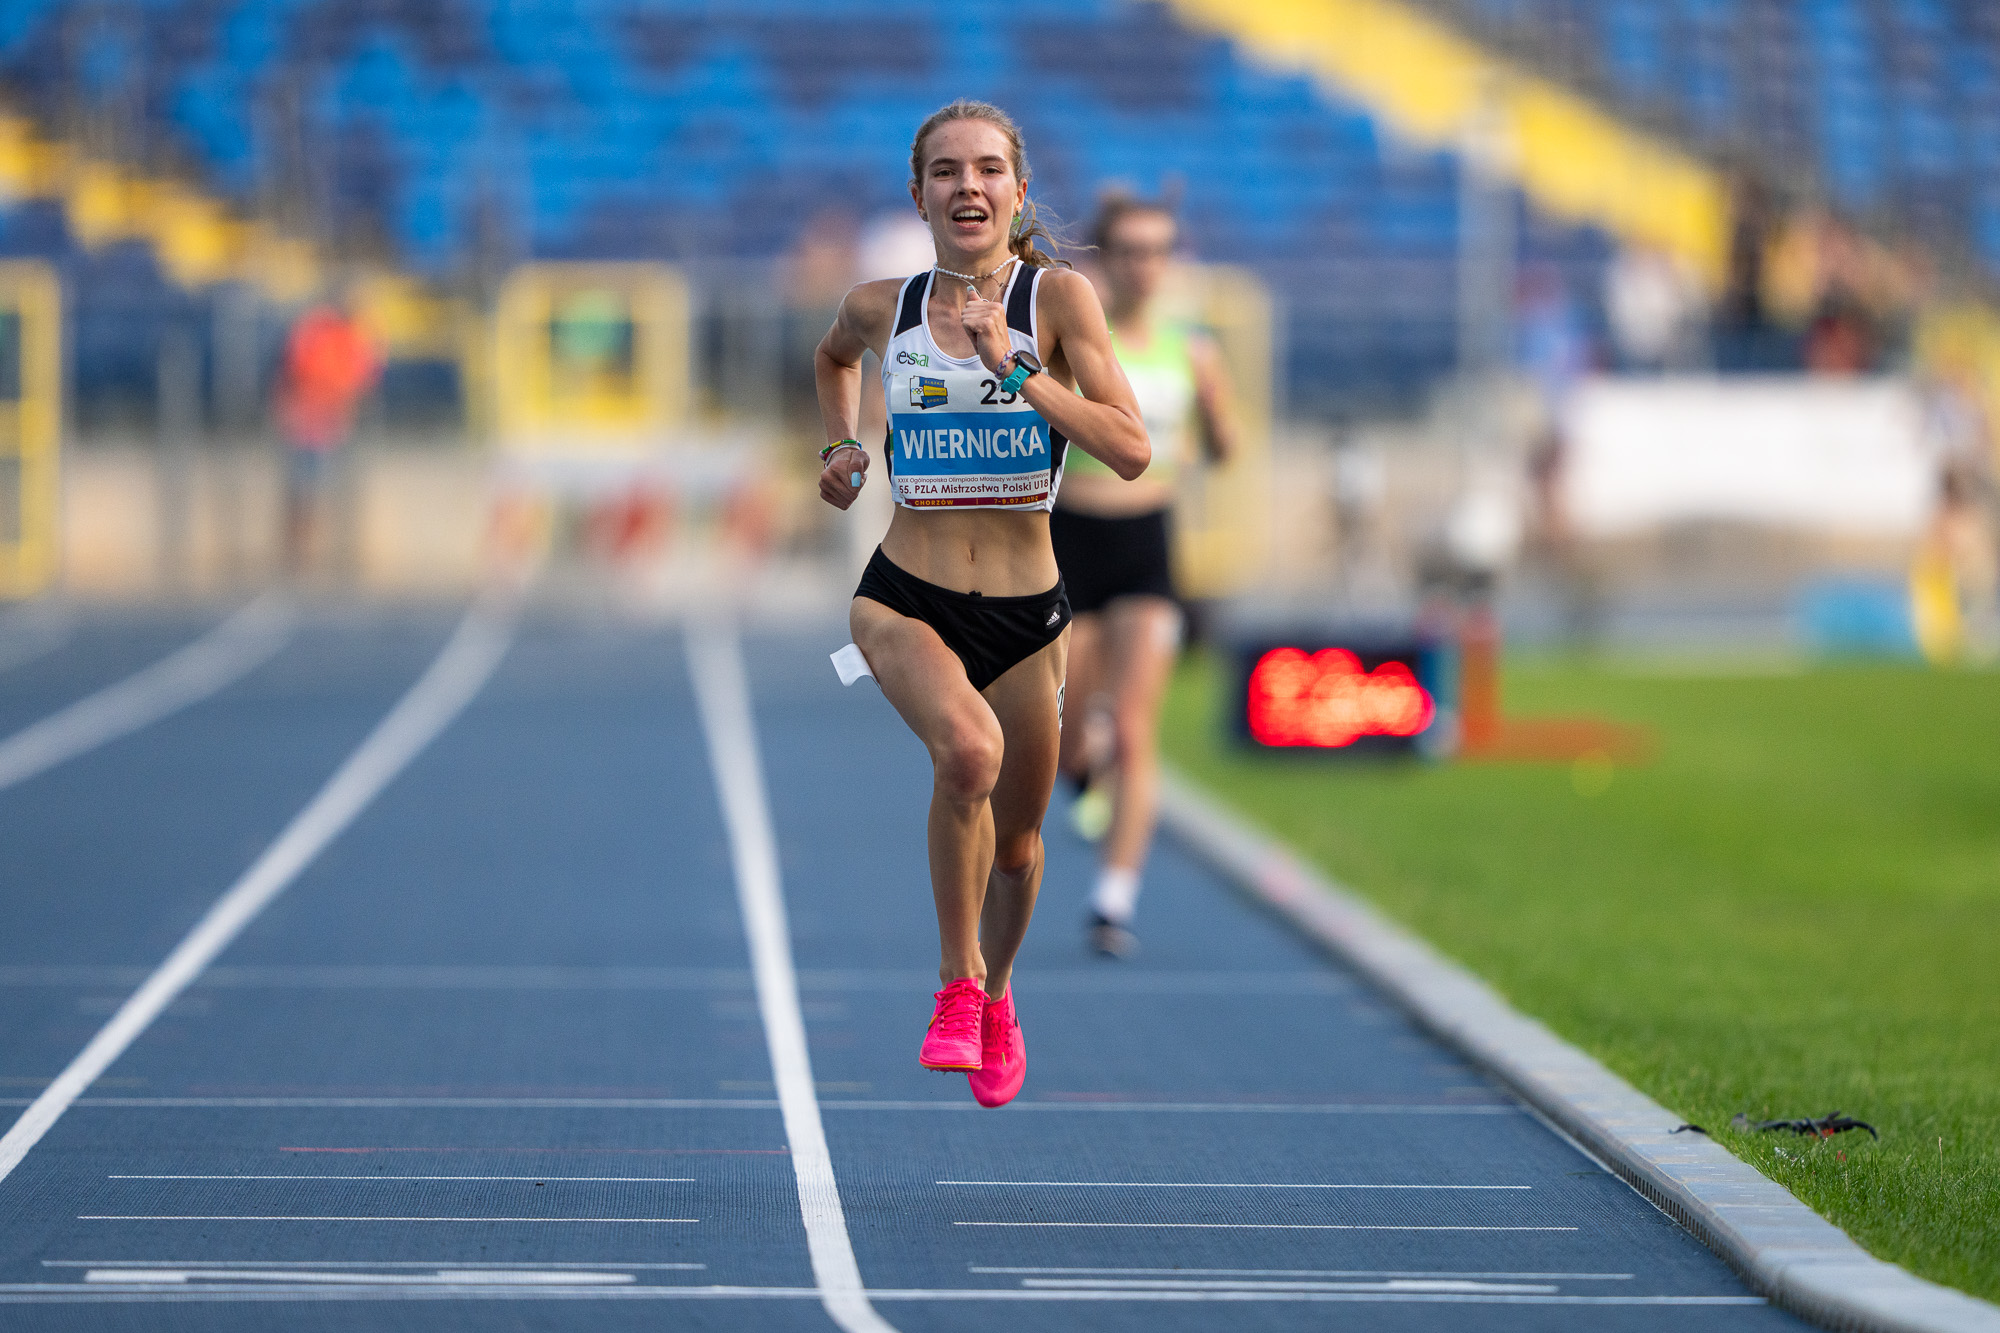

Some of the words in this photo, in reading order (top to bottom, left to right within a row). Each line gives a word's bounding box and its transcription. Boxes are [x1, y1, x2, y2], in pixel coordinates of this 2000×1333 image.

[980, 378, 1026, 405] 25
[900, 426, 1045, 459] WIERNICKA
[910, 477, 947, 485] Ogólnopolska
[980, 475, 1005, 483] Młodzieży
[915, 484, 938, 494] PZLA
[941, 483, 999, 494] Mistrzostwa
[1002, 481, 1032, 492] Polski
[1034, 479, 1049, 490] U18
[914, 498, 954, 506] CHORZÓW
